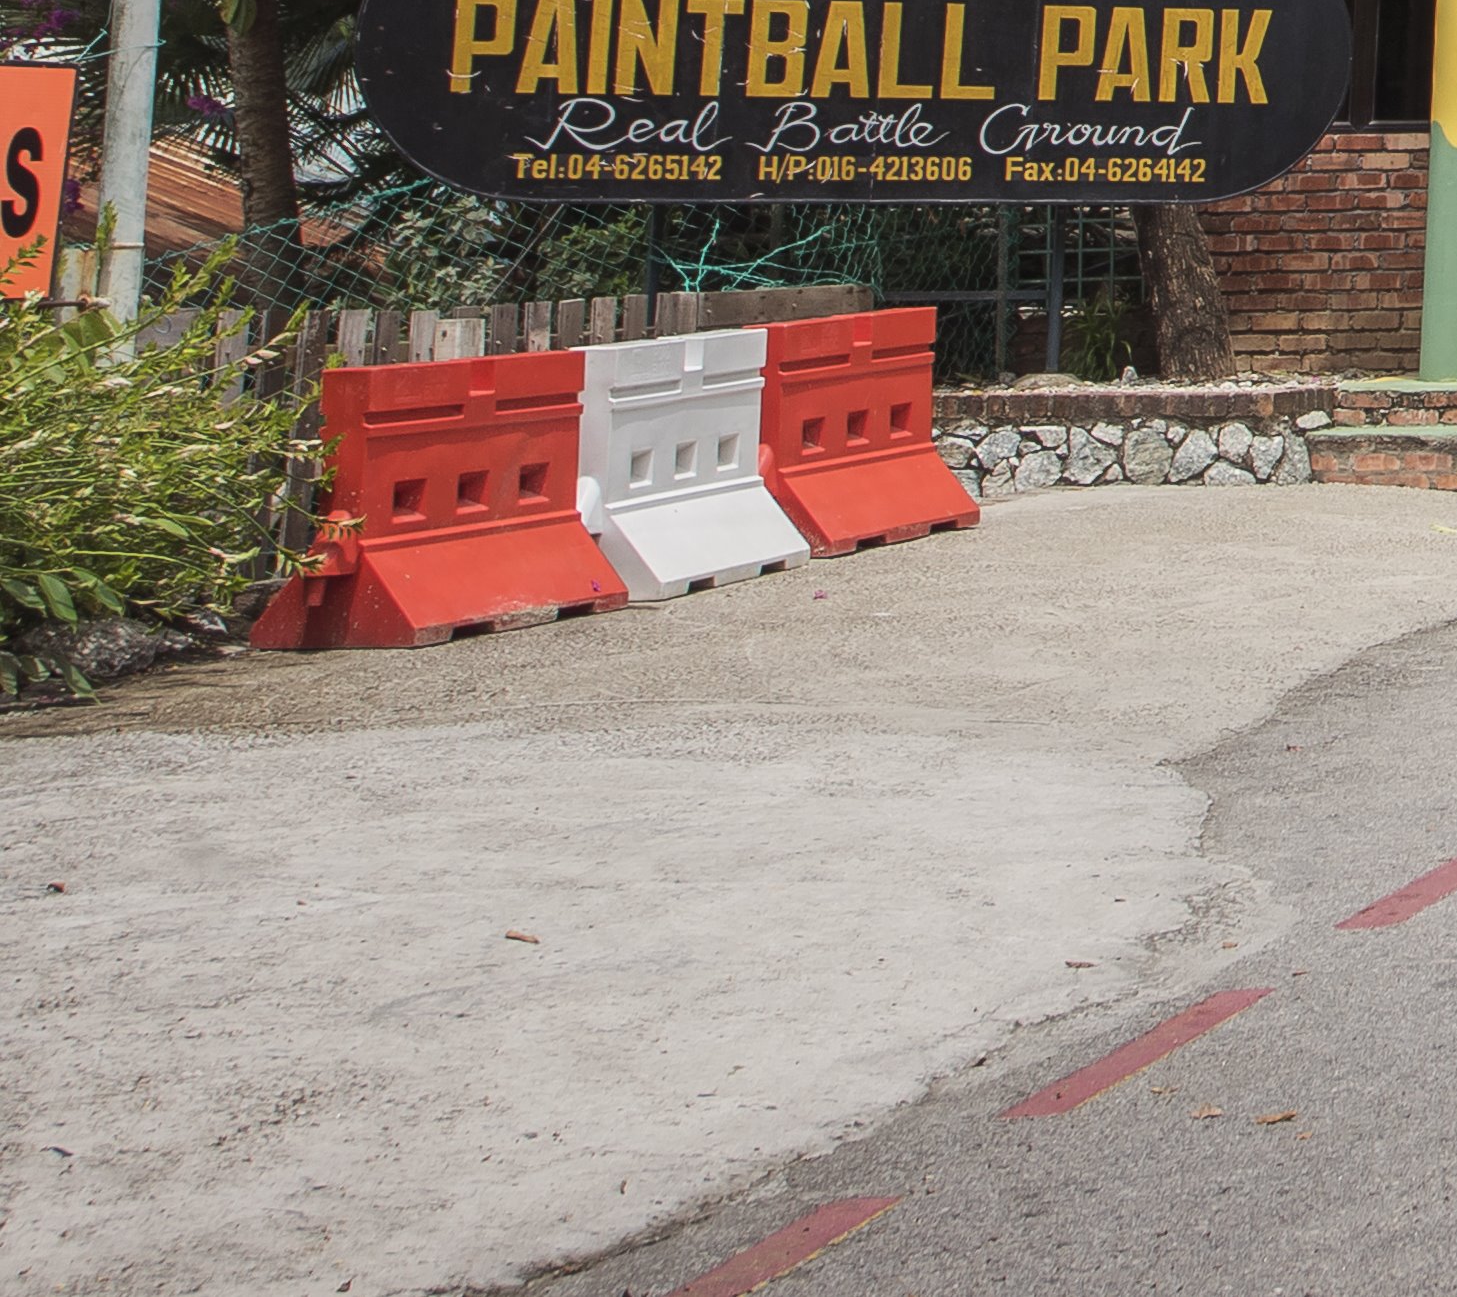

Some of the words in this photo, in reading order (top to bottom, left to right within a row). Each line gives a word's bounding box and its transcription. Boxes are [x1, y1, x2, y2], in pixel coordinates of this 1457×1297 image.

[1036, 4, 1275, 106] PARK
[525, 97, 731, 154] Real
[744, 101, 950, 155] Battle
[978, 102, 1203, 158] Ground
[514, 154, 723, 183] Tel:04-6265142
[758, 155, 973, 187] H/P:016-4213606
[1004, 155, 1207, 184] Fax:04-6264142
